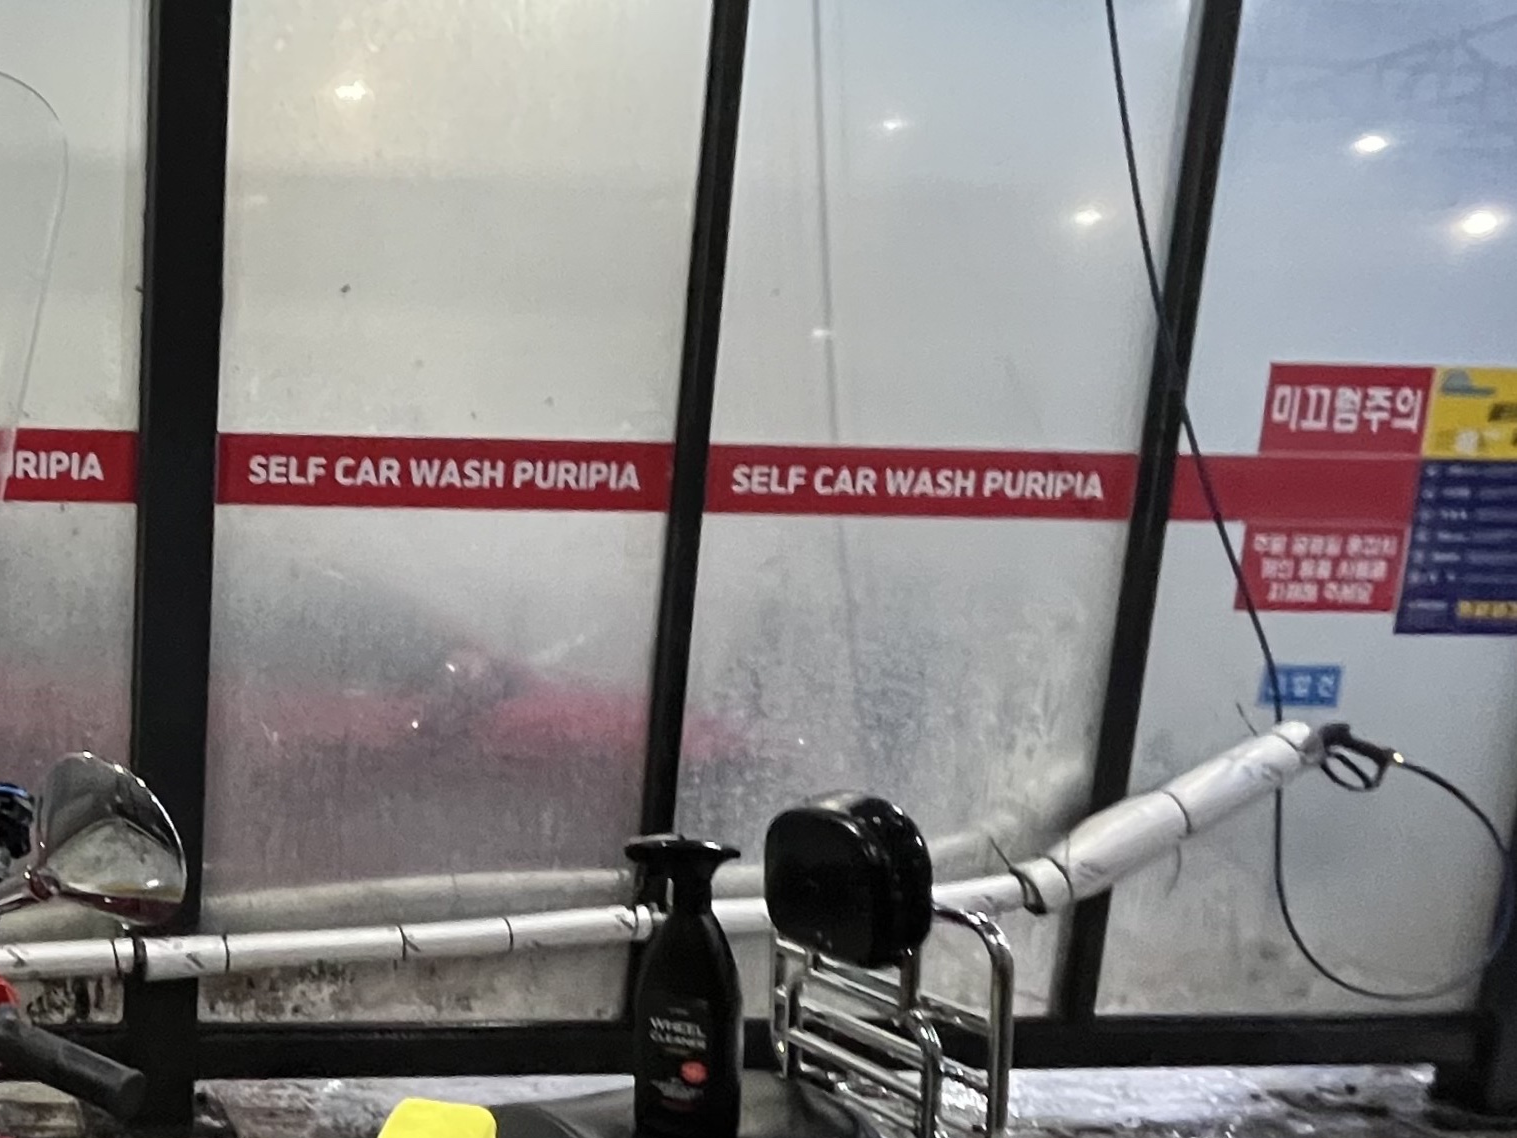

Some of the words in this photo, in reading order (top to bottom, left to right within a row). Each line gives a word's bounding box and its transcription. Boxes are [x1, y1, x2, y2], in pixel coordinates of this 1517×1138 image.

[247, 454, 328, 486] SELF
[334, 456, 401, 487] CAR
[409, 458, 504, 489] WASH
[512, 460, 640, 491] PURIPIA
[731, 463, 807, 495] SELF
[813, 466, 877, 496] CAR
[884, 467, 975, 498] WASH
[983, 469, 1103, 501] PURIPIA
[649, 1016, 707, 1039] WHEEL
